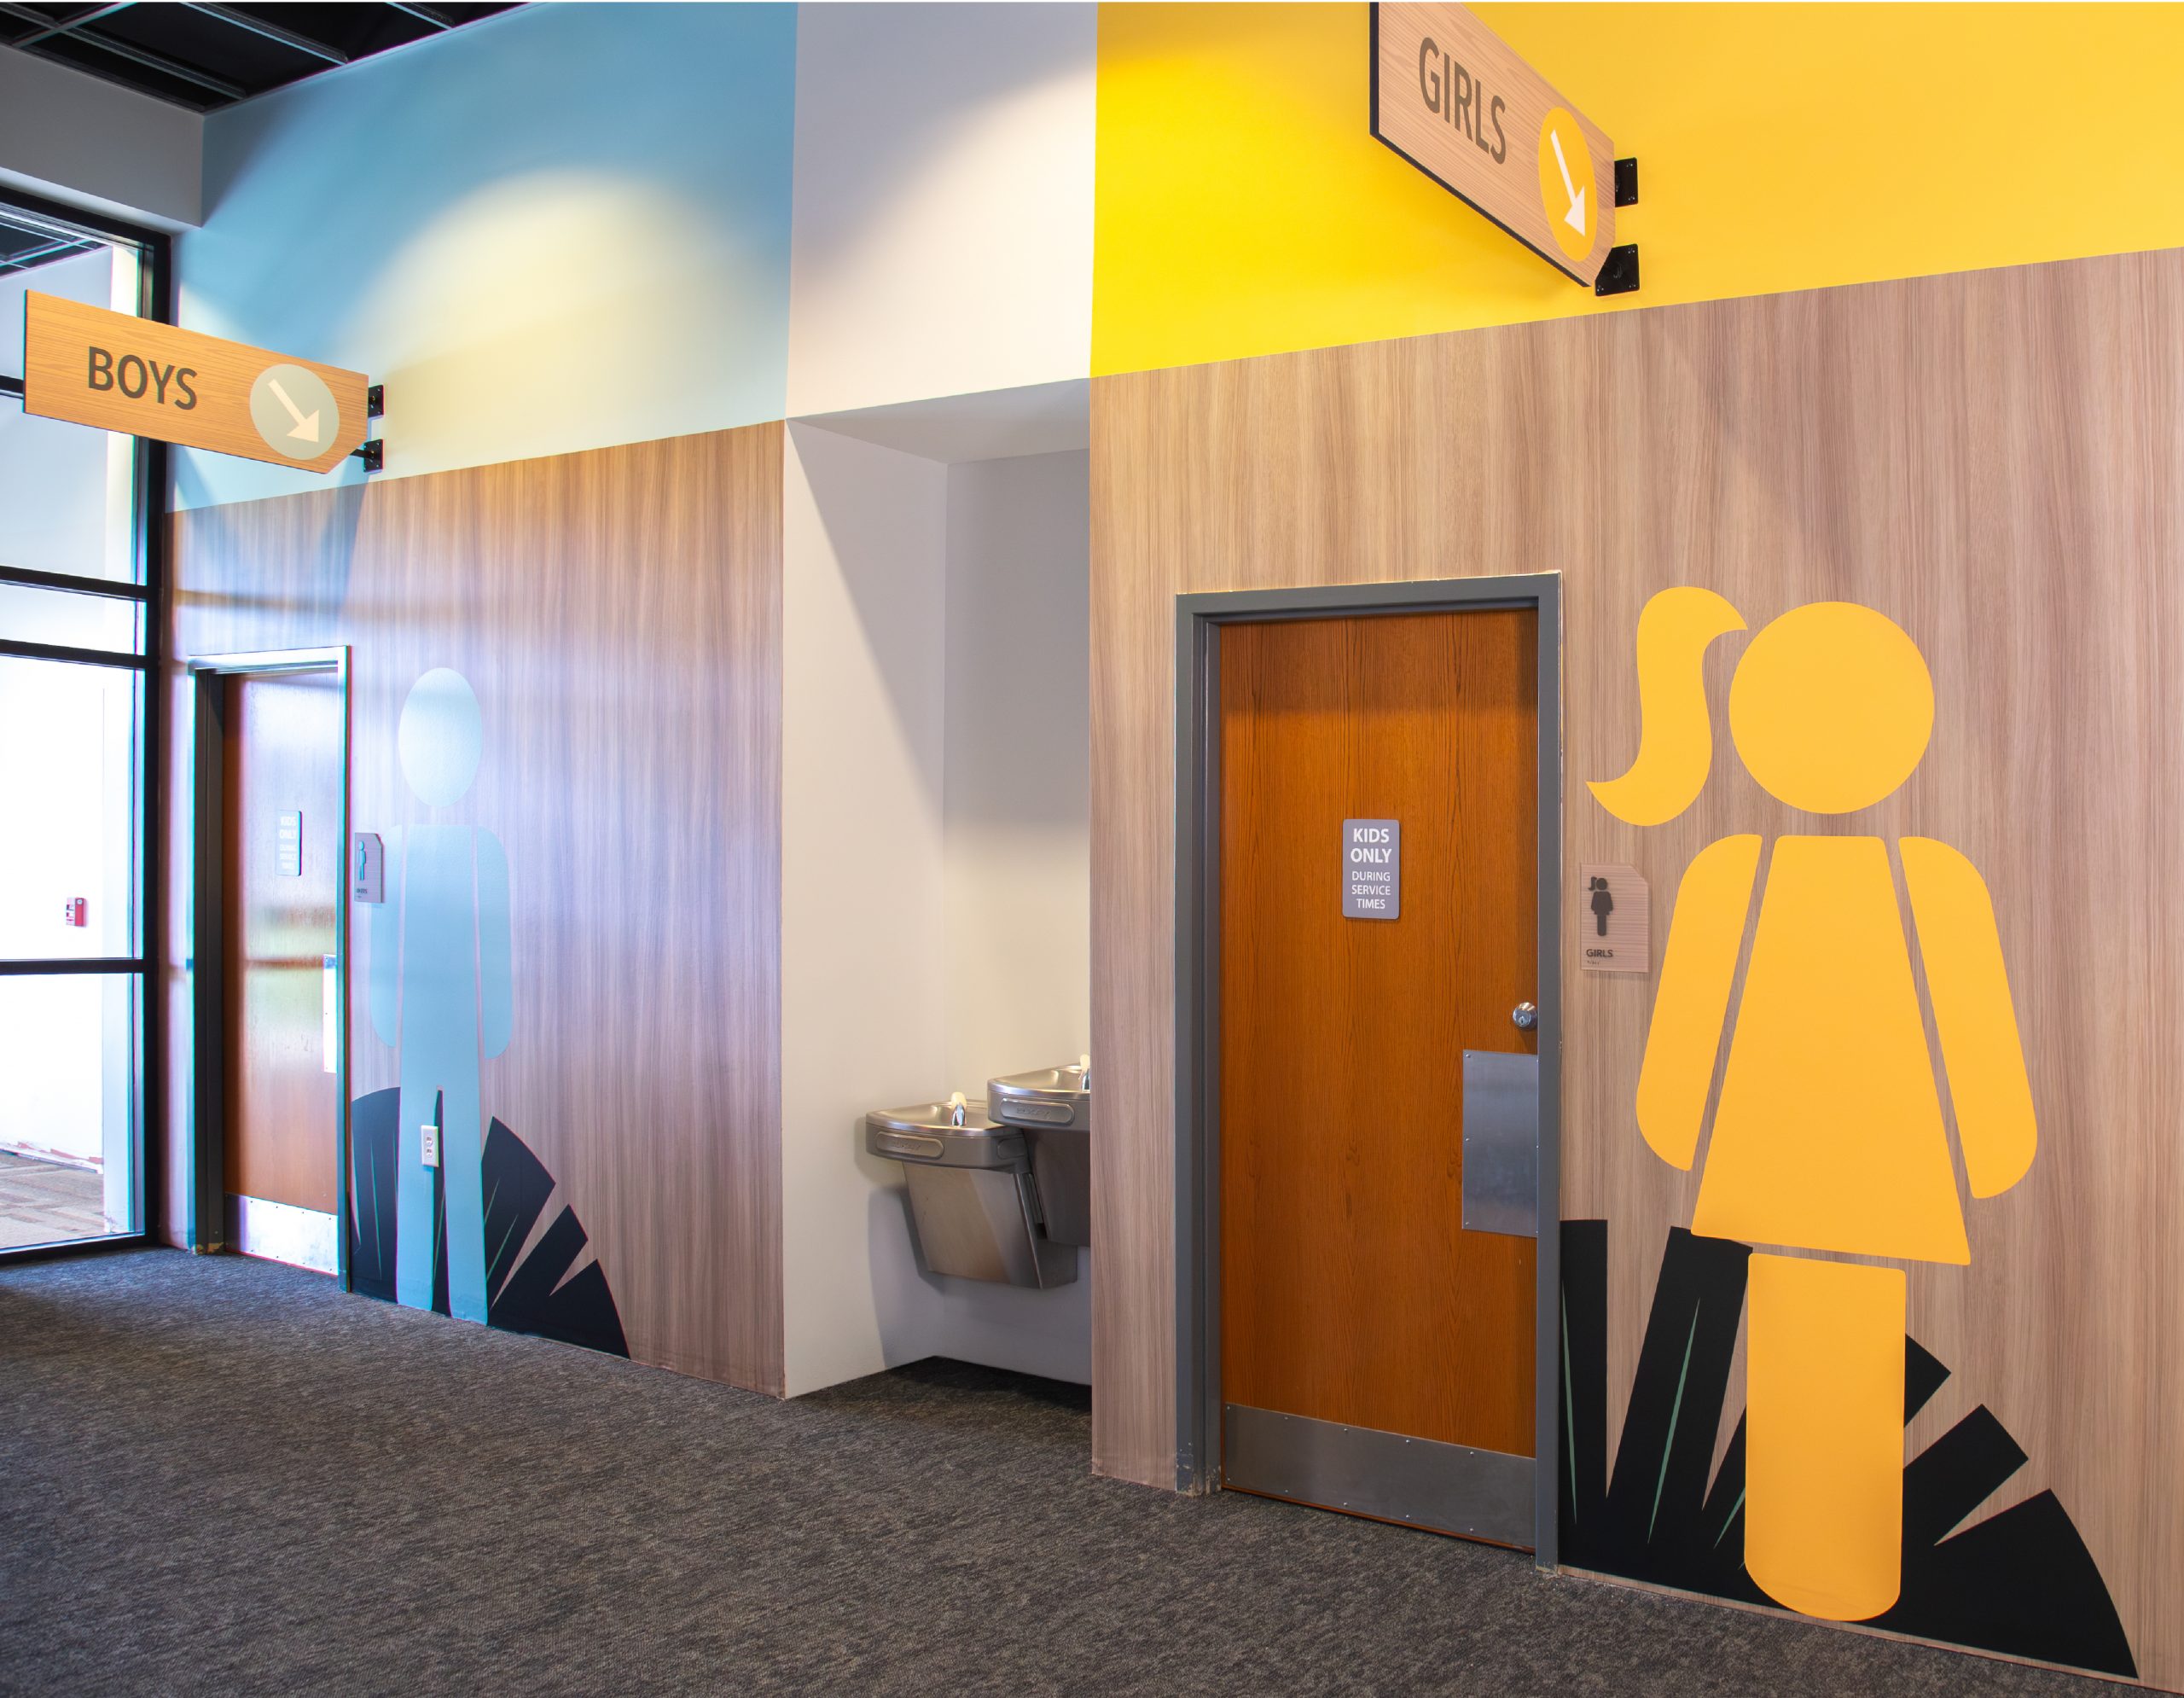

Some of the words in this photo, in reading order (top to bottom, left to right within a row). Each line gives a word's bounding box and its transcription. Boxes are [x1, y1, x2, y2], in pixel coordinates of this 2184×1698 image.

[1419, 37, 1507, 165] GIRLS
[88, 346, 198, 410] BOYS
[1353, 828, 1390, 843] KIDS
[1350, 847, 1392, 864] ONLY
[1351, 870, 1391, 881] DURING
[1351, 885, 1391, 896] SERVICE
[1356, 898, 1385, 910] TIMES
[1586, 948, 1614, 957] GIRLS
